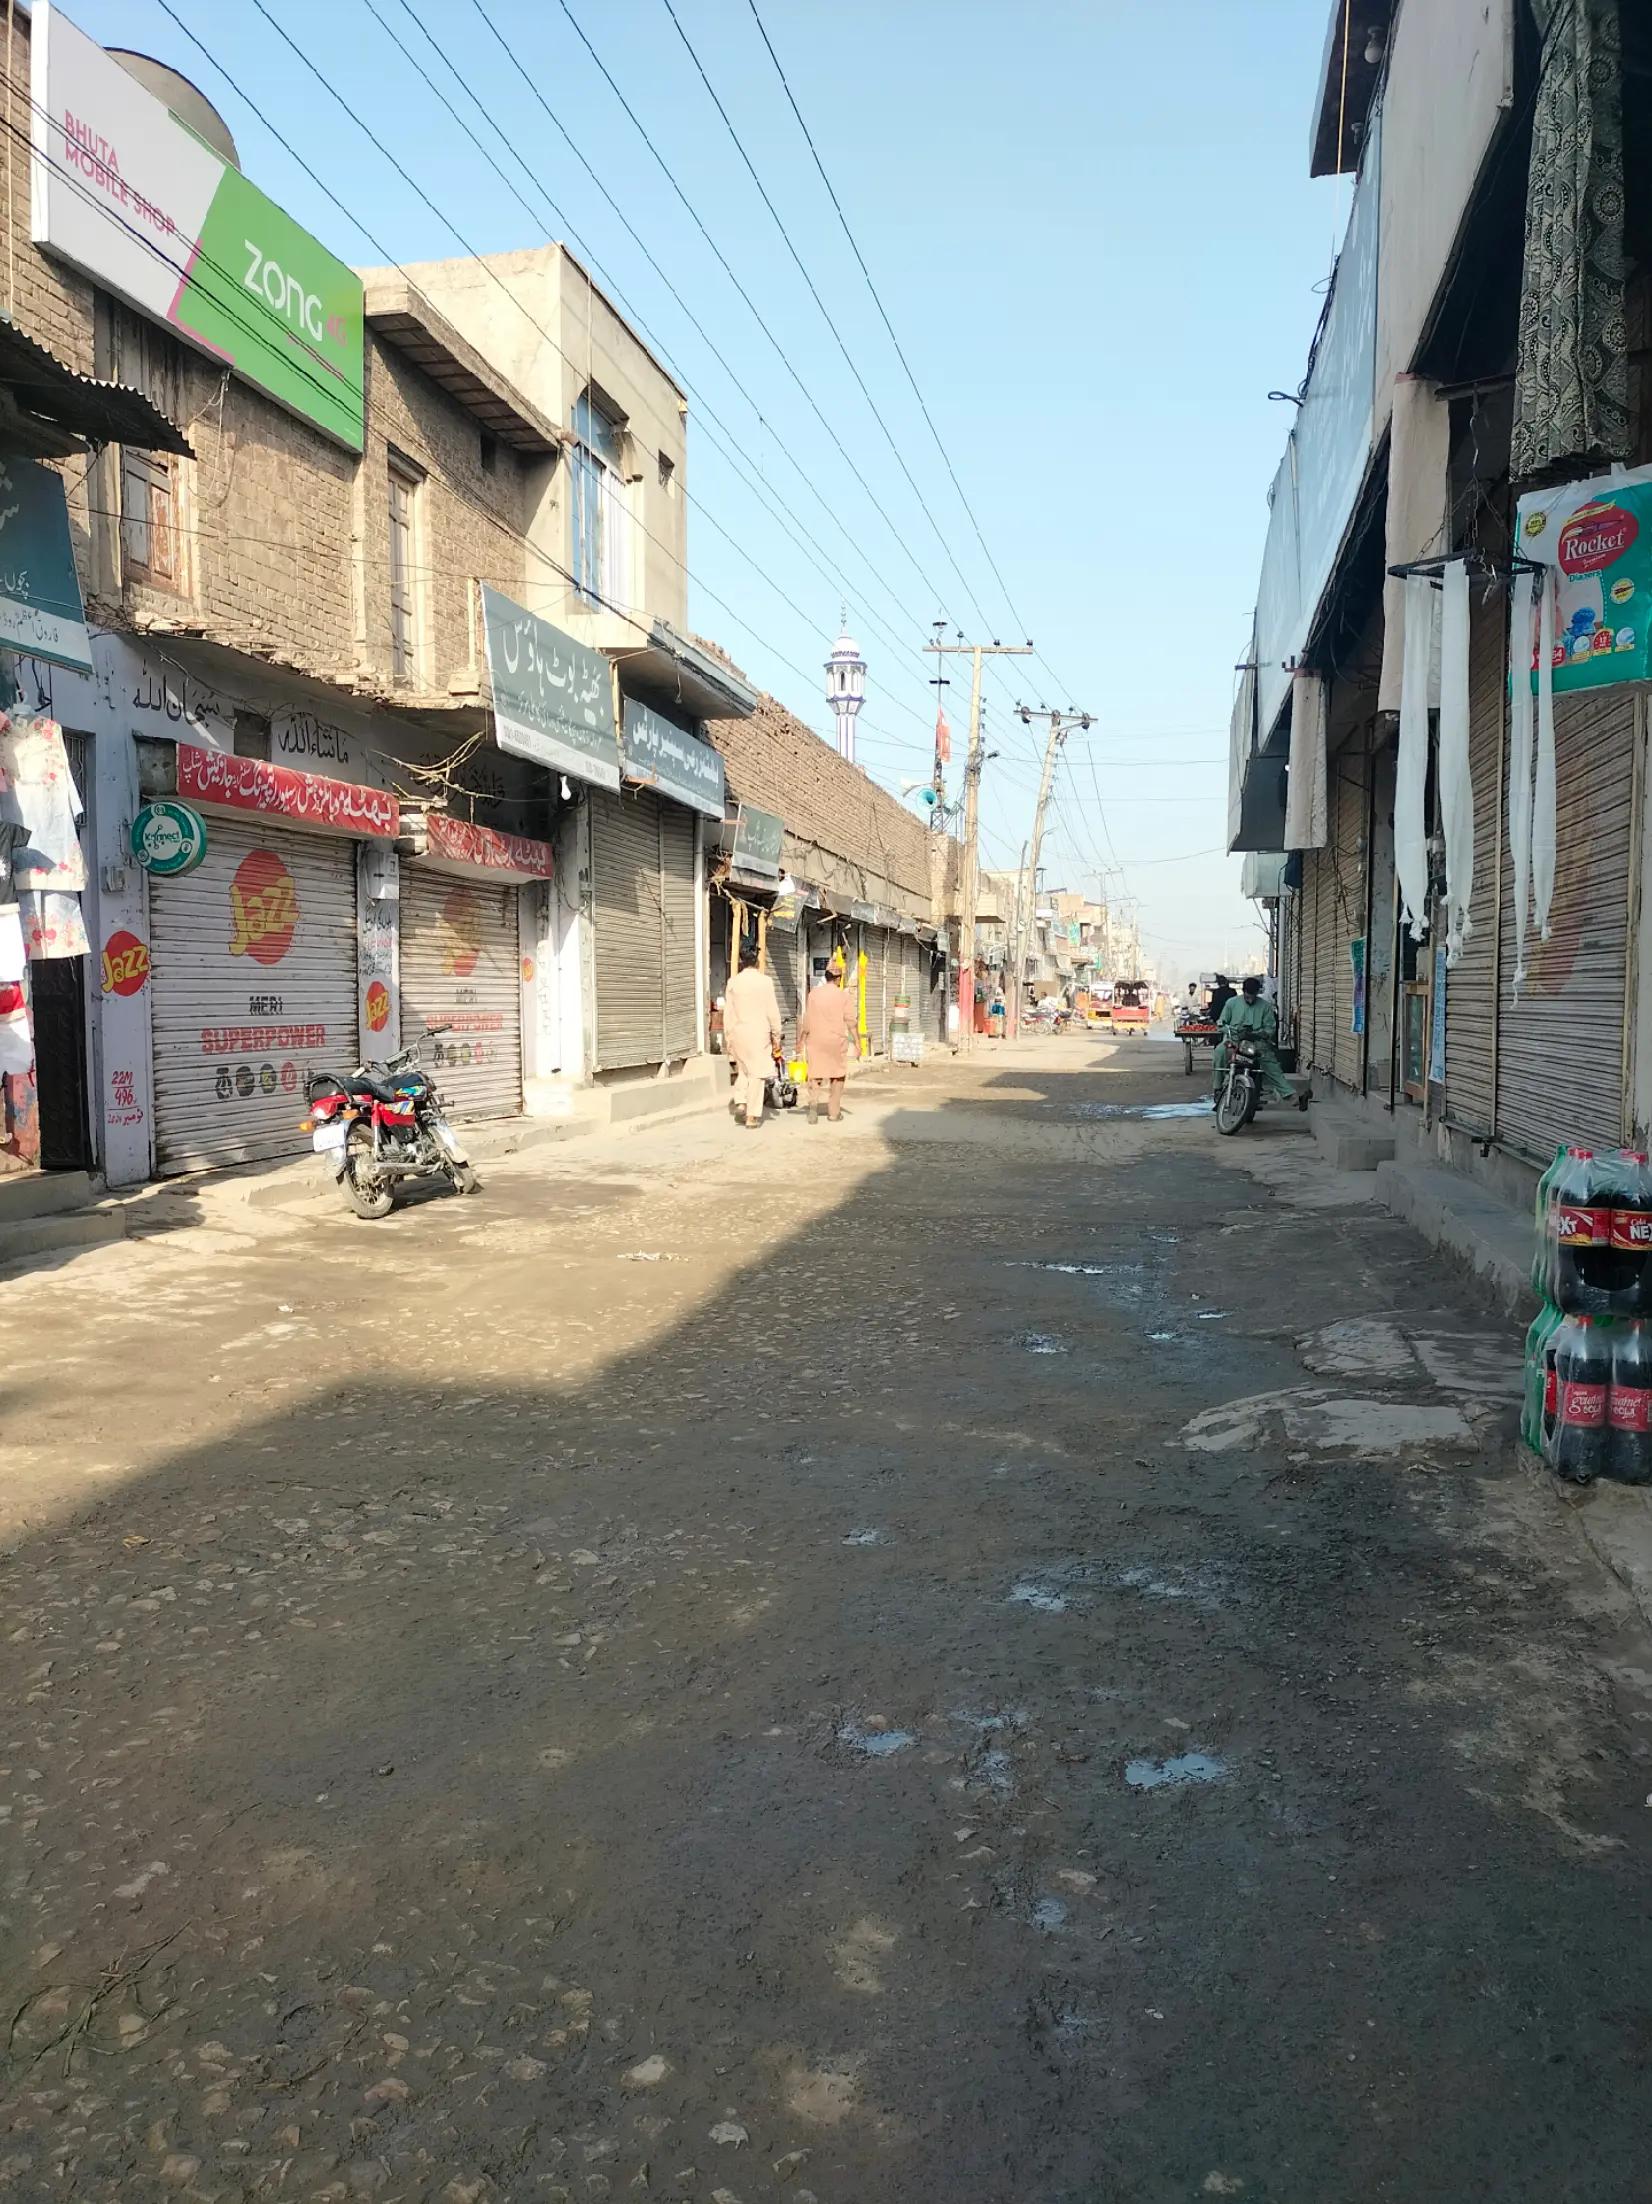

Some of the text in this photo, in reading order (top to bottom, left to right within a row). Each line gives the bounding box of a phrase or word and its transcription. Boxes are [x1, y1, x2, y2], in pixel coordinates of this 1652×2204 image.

[65, 109, 119, 173] BHUTA
[65, 139, 176, 236] MOBILE SHOP
[1564, 529, 1625, 561] Rocket
[342, 784, 393, 832] بھٹہ
[101, 945, 149, 993] Jazz
[249, 996, 284, 1015] MERI
[366, 991, 390, 1030] Jazz
[201, 1024, 325, 1053] SUPERPOWER
